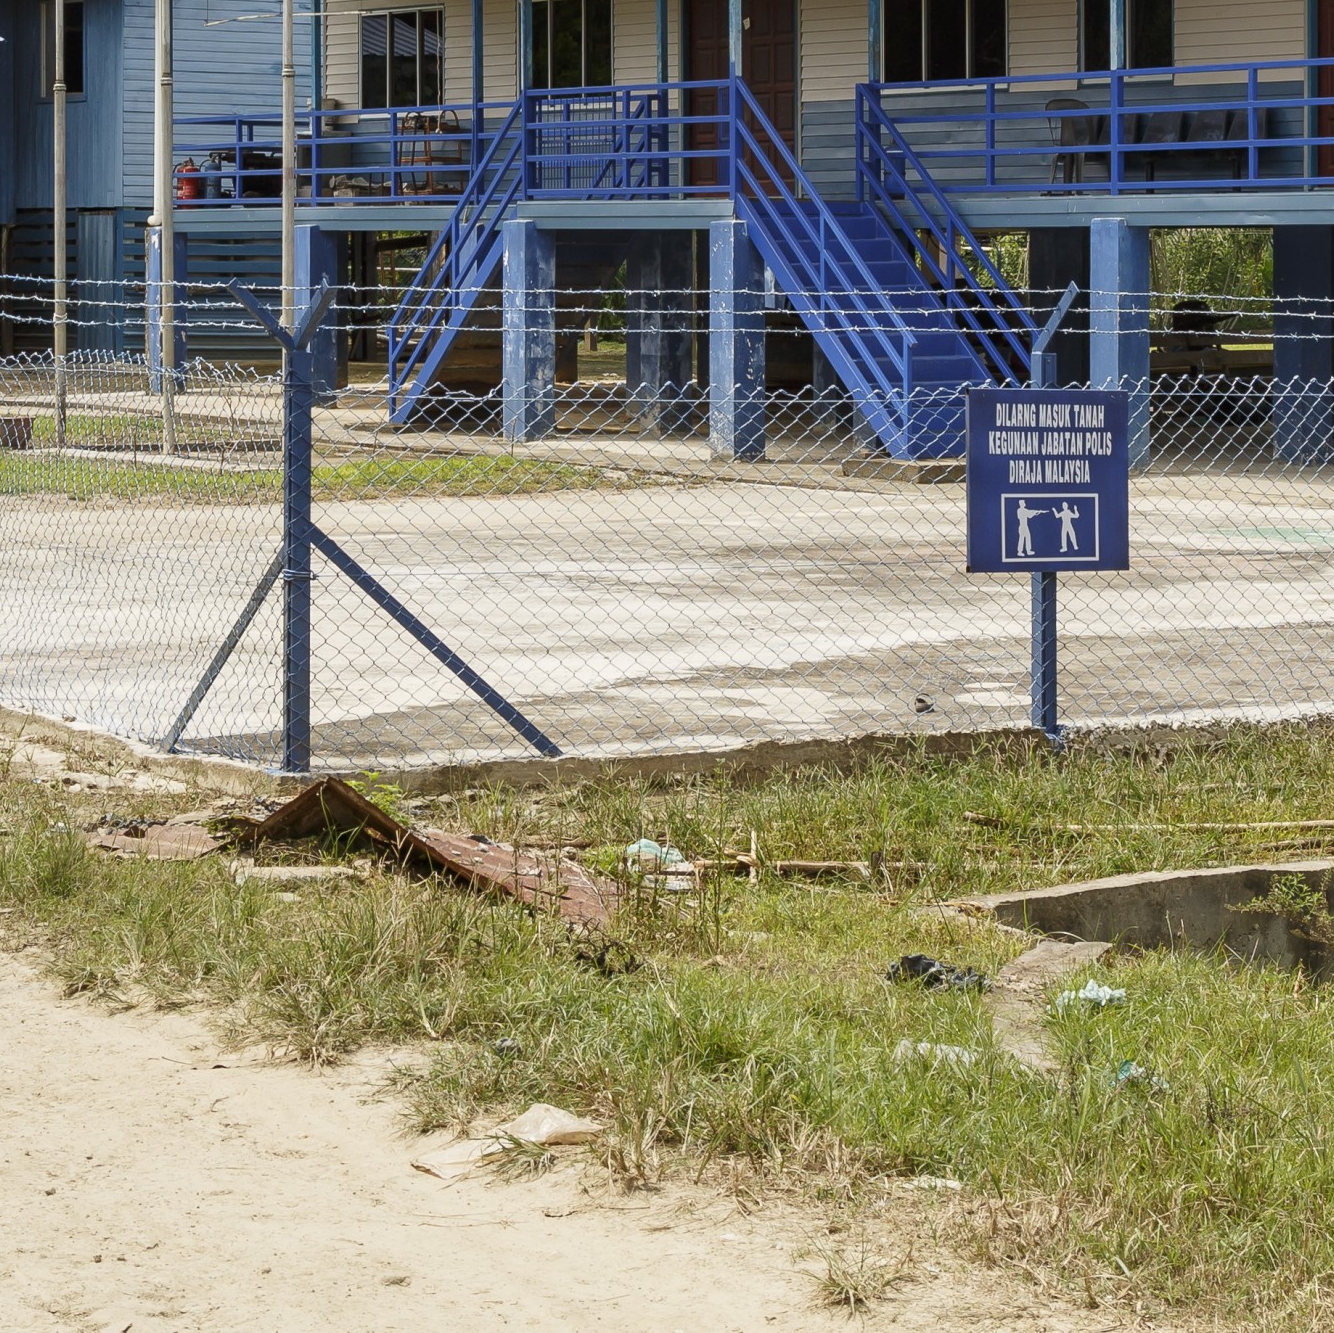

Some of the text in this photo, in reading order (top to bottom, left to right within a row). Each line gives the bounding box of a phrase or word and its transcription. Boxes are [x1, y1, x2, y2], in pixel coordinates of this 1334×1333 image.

[996, 403, 1105, 428] DILARNG MASUK TANAH
[989, 431, 1112, 456] KEGUNAAN JABATAN POLIS
[1009, 459, 1090, 483] DIRAJA MALAYSIA
